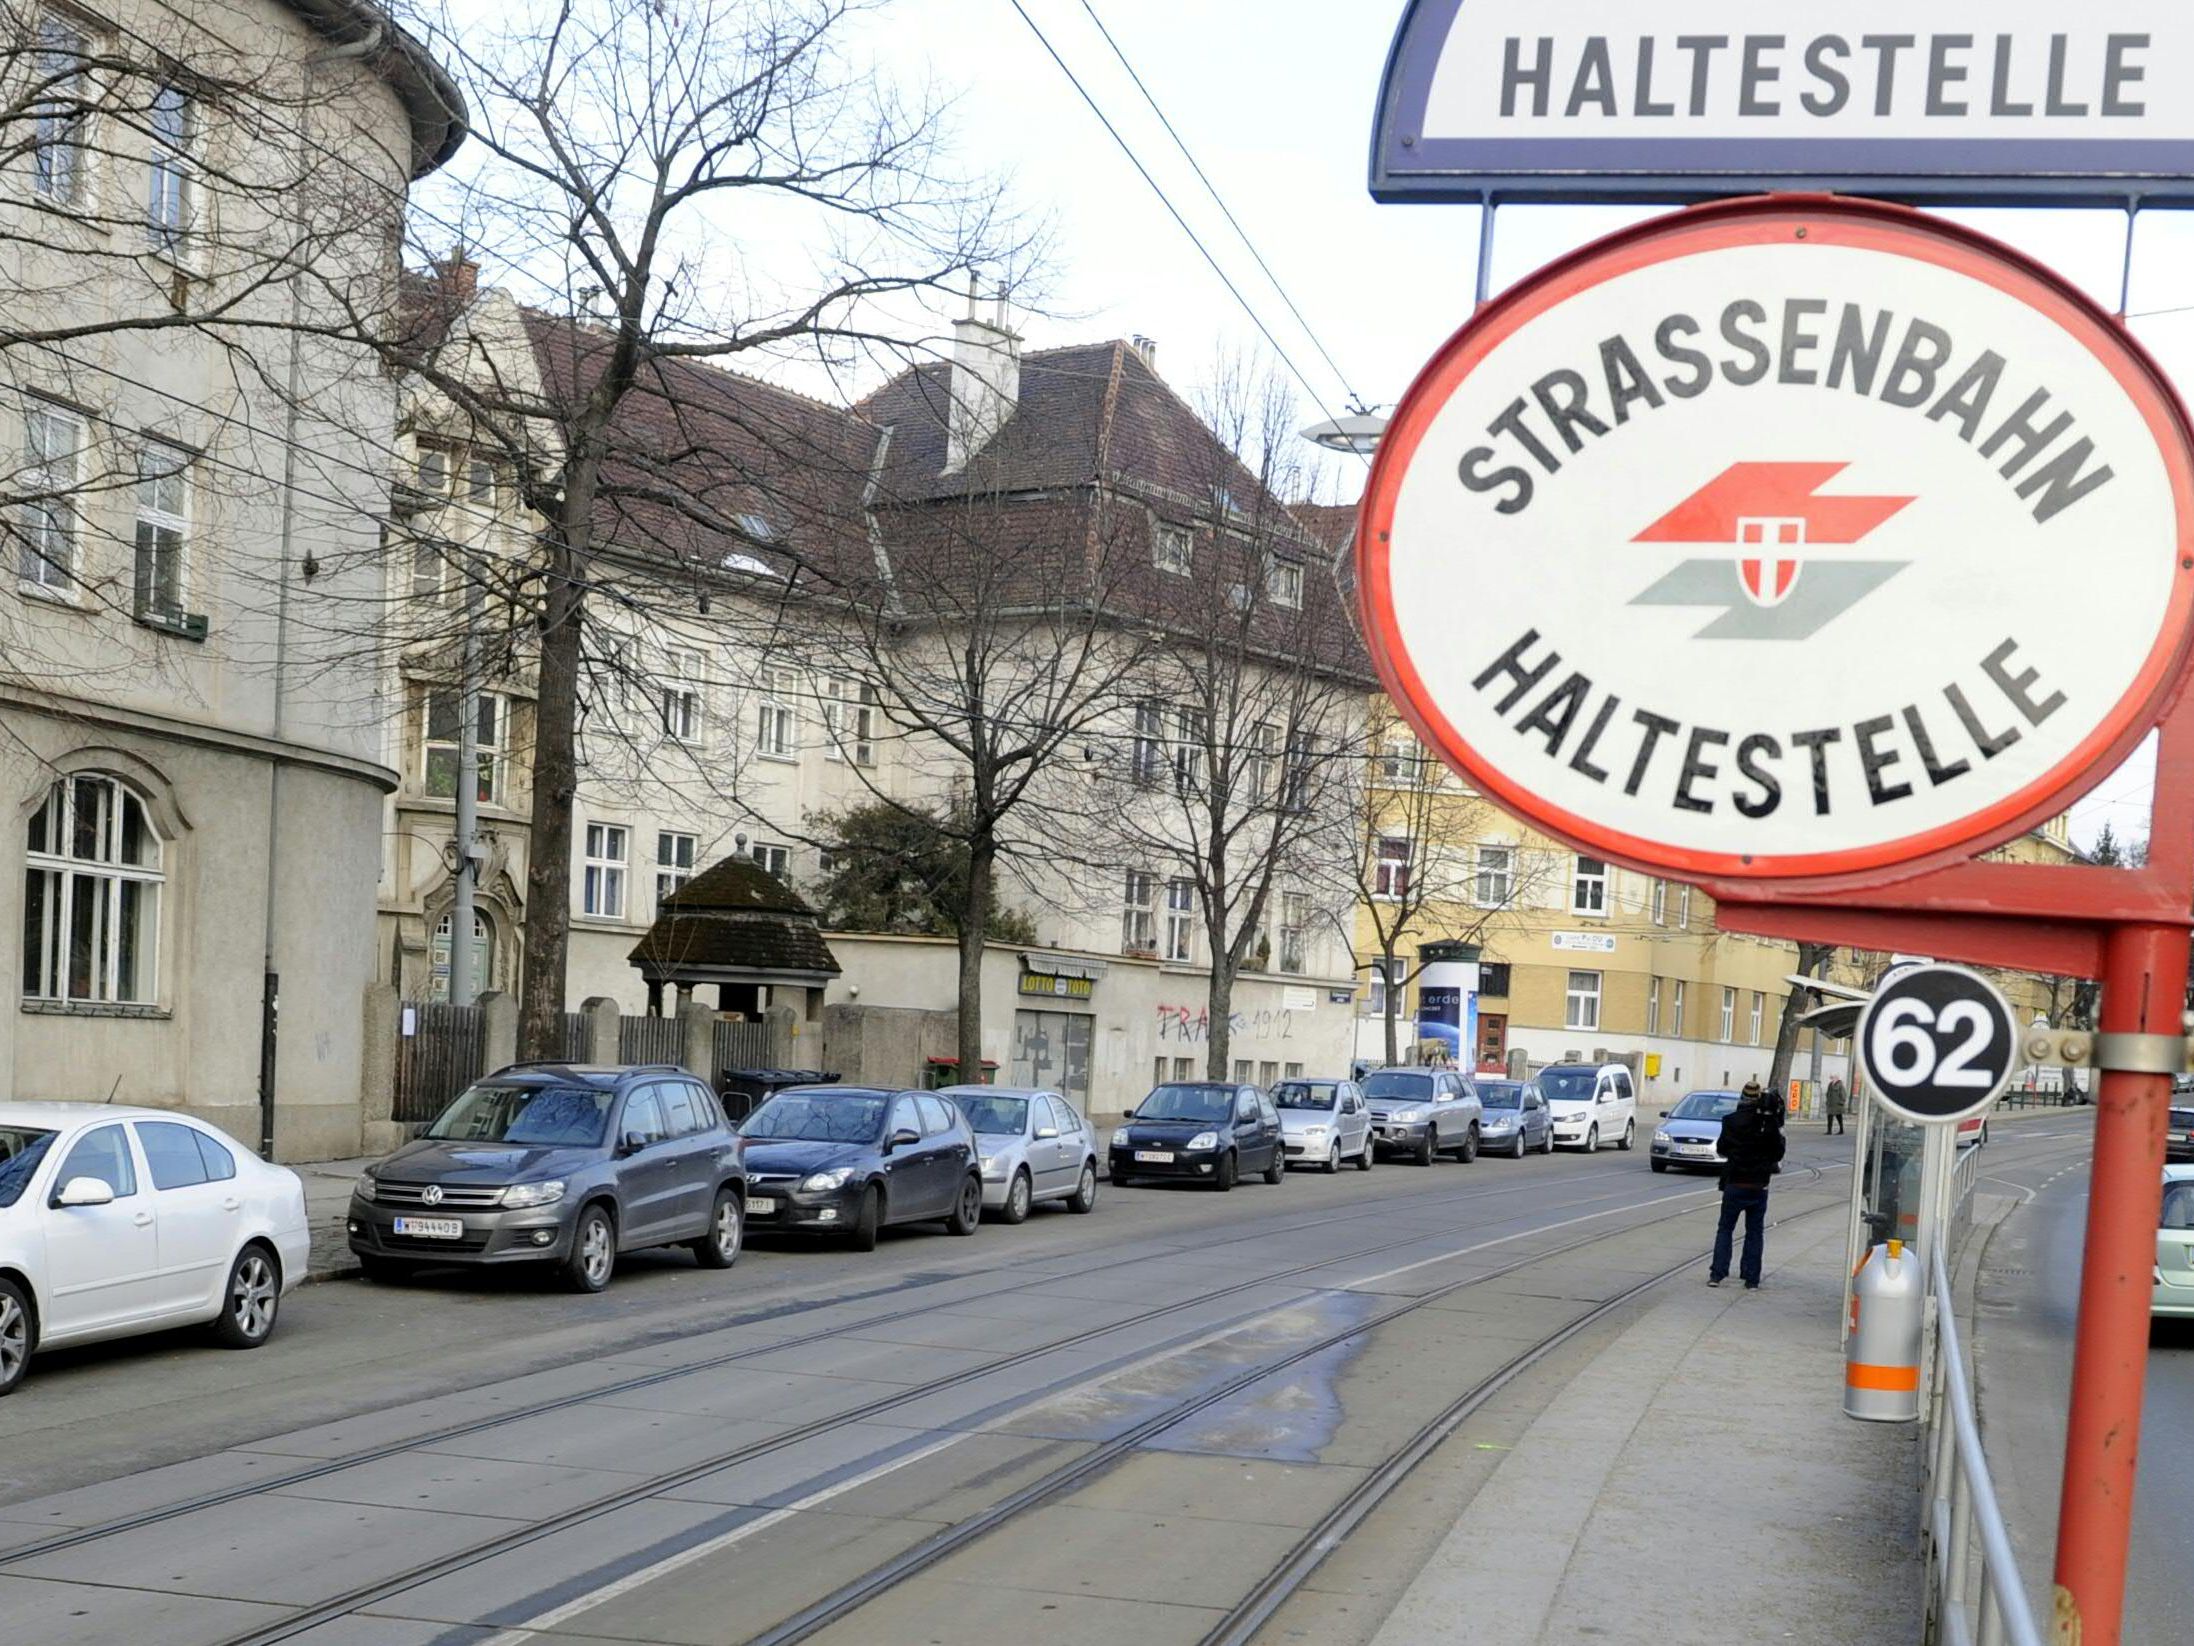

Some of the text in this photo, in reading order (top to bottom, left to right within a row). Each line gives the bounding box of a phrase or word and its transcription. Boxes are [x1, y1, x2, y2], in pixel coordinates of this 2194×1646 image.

[1499, 32, 2151, 118] HALTESTELLE
[1458, 298, 2114, 524] STRASSENBAHN
[1471, 628, 2067, 820] HALTESTELLE
[1023, 975, 1055, 993] LOTTO
[1067, 979, 1092, 996] TOTO
[1871, 997, 1995, 1089] 62
